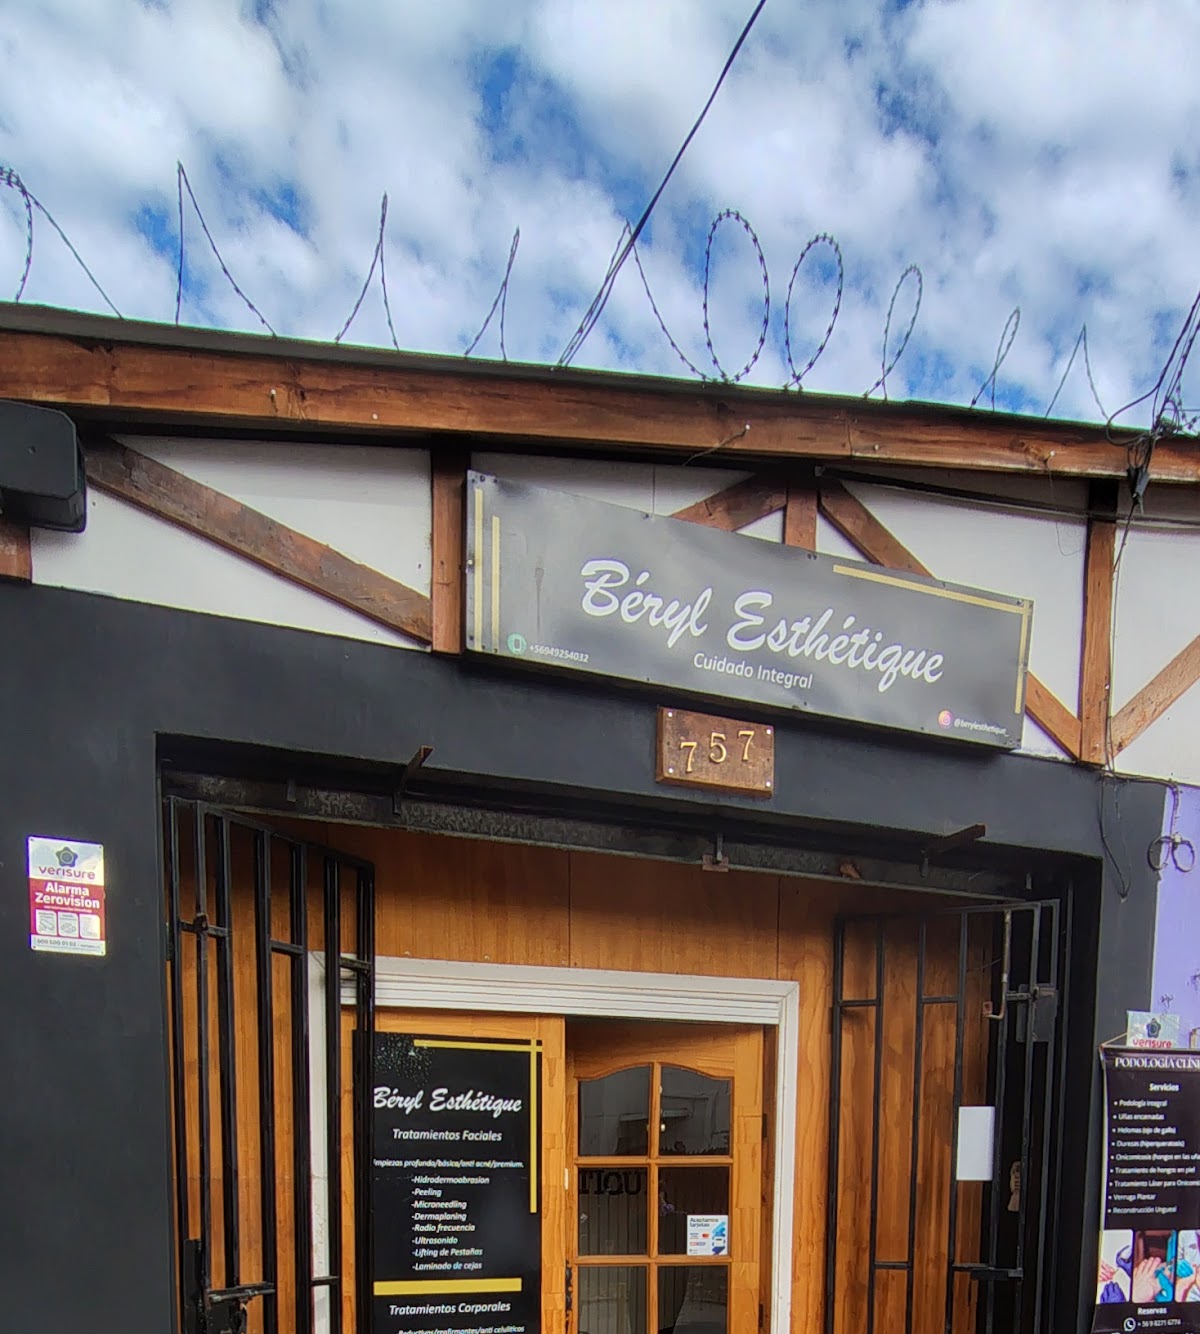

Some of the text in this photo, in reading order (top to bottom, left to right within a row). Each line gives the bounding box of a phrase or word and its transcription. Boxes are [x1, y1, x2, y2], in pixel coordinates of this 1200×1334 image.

[581, 560, 945, 692] Béryl Esthétique
[529, 645, 589, 663] +56949254032
[693, 652, 813, 690] Cuidado Integral
[679, 730, 755, 774] 757
[39, 866, 95, 880] verisure
[45, 882, 89, 896] Alarma
[35, 892, 100, 909] Zerovision
[1133, 1038, 1172, 1048] verisure
[1115, 1055, 1200, 1069] PODOLOGÍA CLÍNI
[1149, 1083, 1179, 1091] Servicios
[374, 1086, 522, 1118] Béryl Esthétique
[392, 1128, 502, 1141] Tratamientos Faciales
[373, 1159, 403, 1168] impiezas
[412, 1188, 442, 1197] -Peeling
[411, 1200, 467, 1210] -Microneedling
[411, 1212, 467, 1222] -Dermaplaning
[411, 1223, 476, 1233] -Radio frecuencia
[412, 1236, 459, 1244] -Ultrasonido
[412, 1247, 483, 1258] -Lifting de Pestañas
[412, 1261, 482, 1271] -Laminado de cejas
[389, 1301, 511, 1316] Tratamientos Corporales
[1137, 1307, 1167, 1315] Reservas
